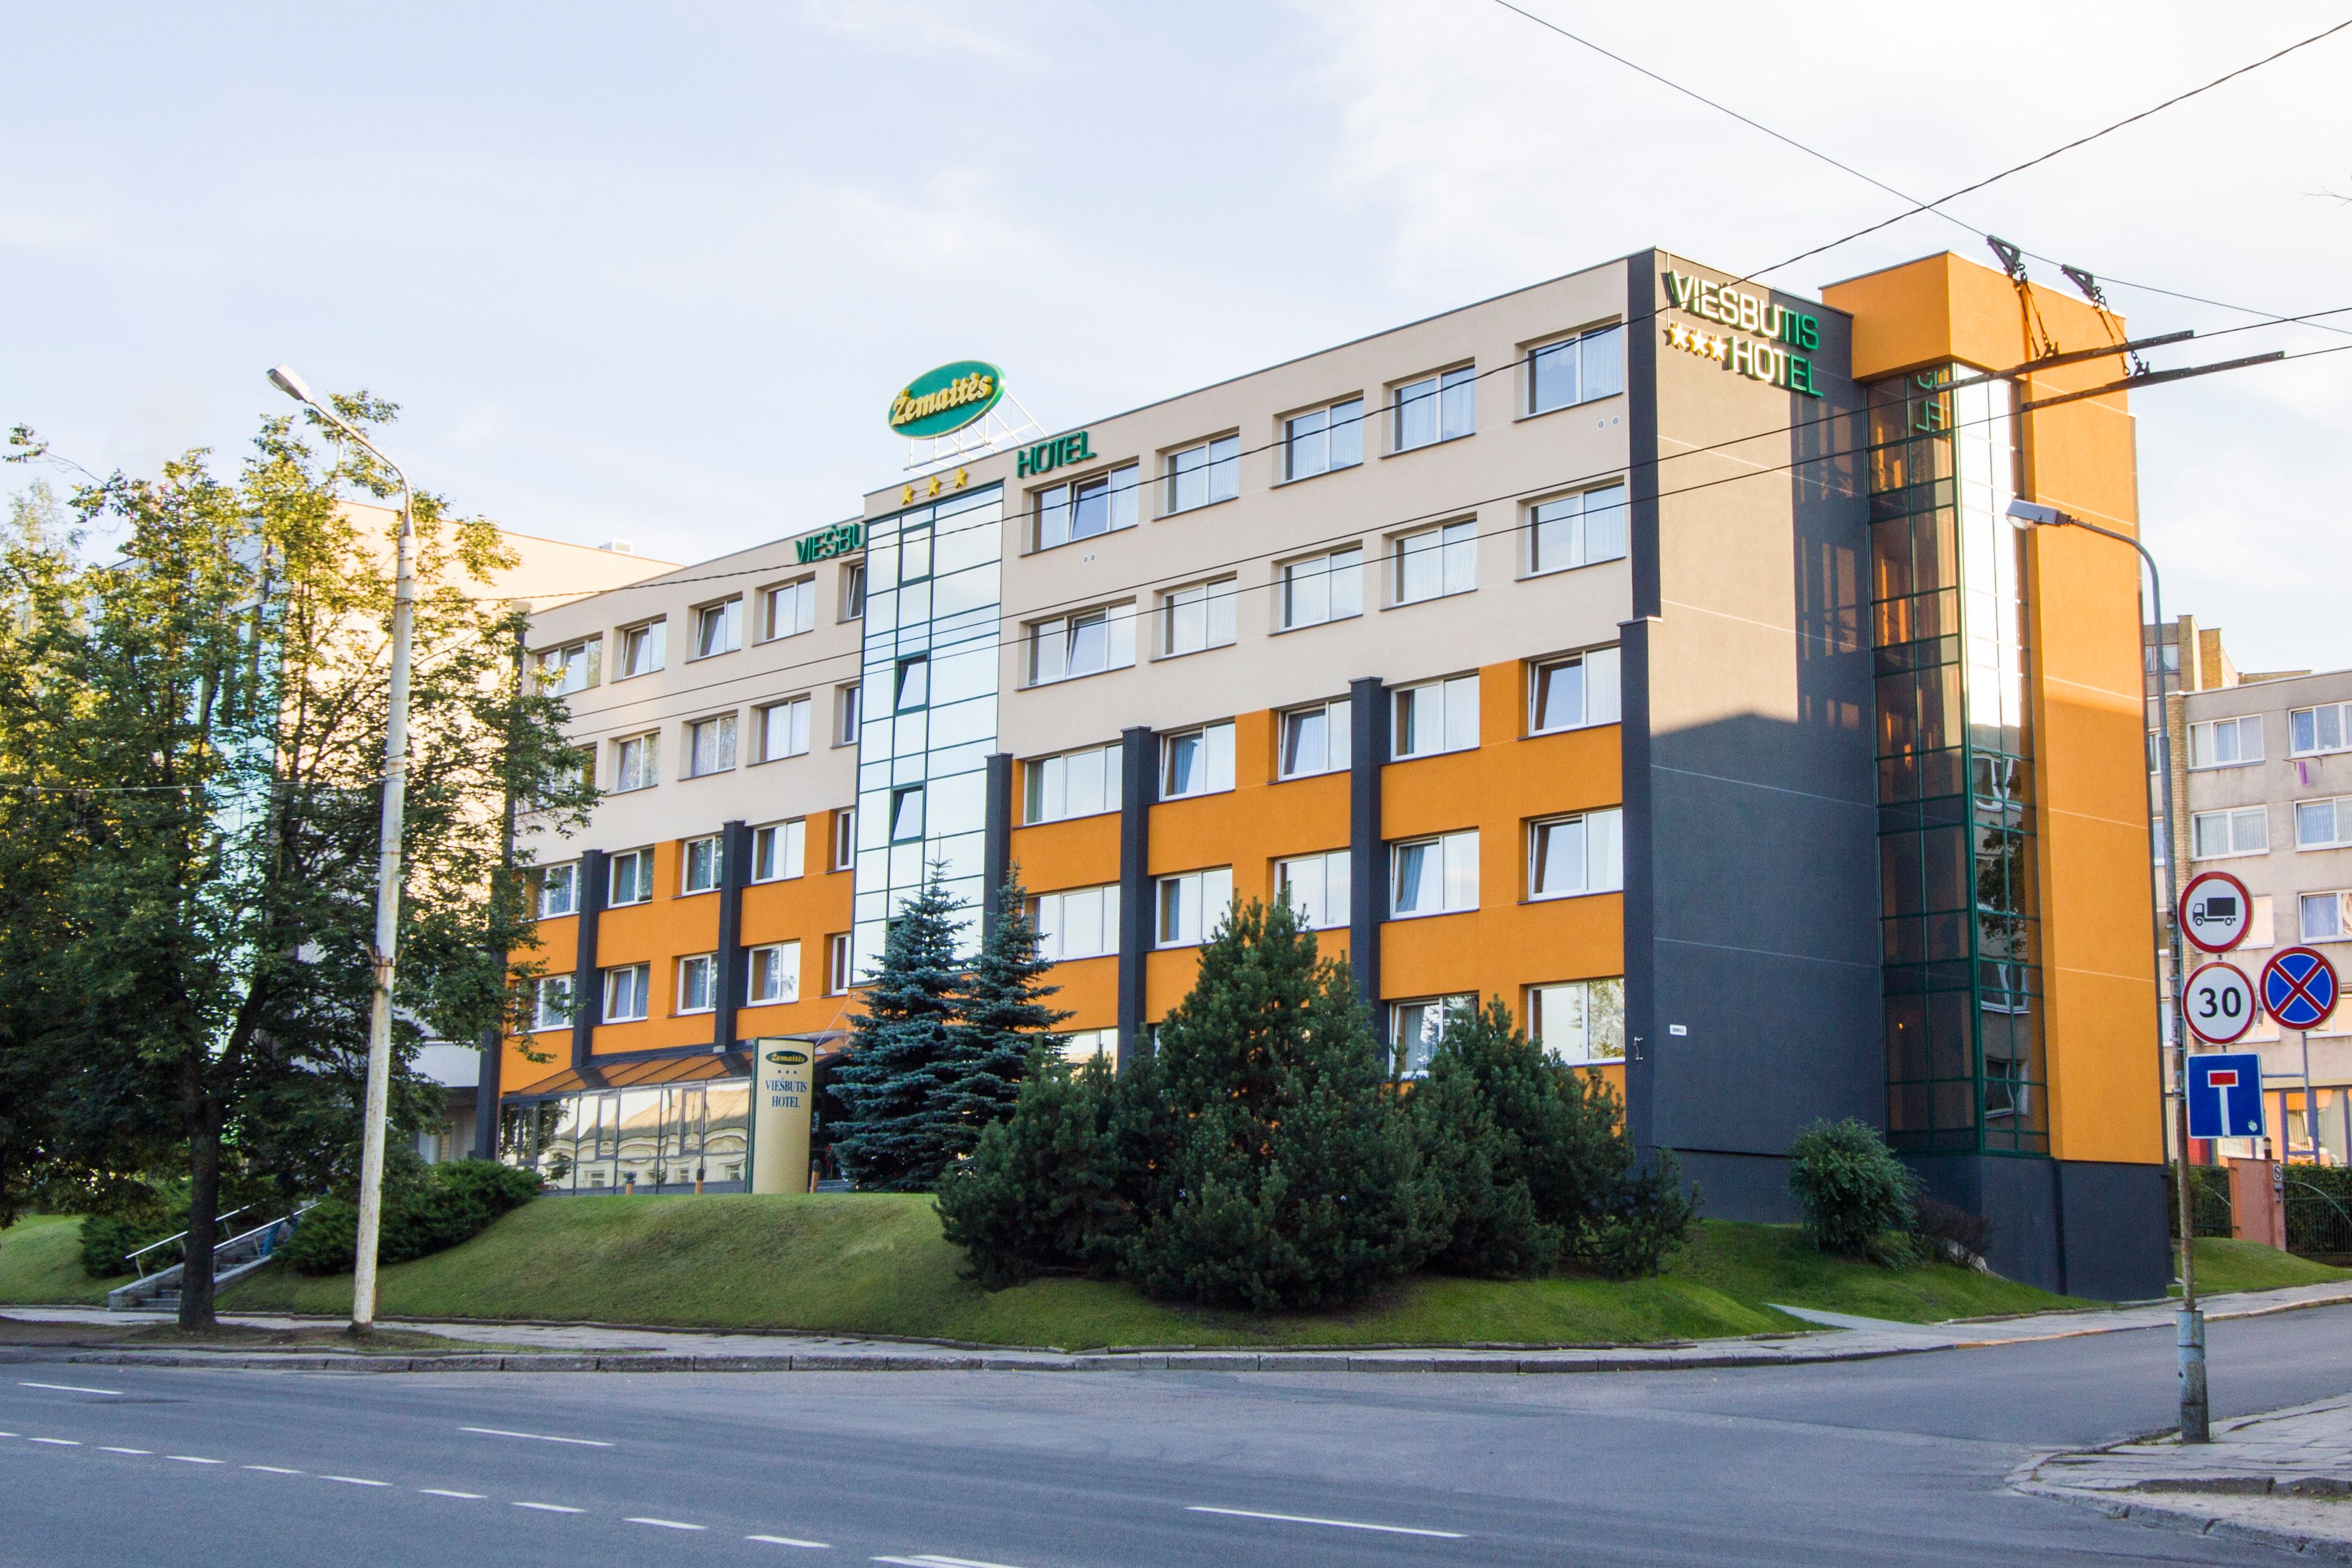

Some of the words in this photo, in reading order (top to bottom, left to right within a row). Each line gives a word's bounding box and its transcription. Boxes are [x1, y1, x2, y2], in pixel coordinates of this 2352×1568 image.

[1728, 335, 1824, 398] HOTEL
[891, 372, 993, 426] Žemaitės
[1017, 430, 1097, 478] HOTEL
[2198, 987, 2242, 1019] 30
[766, 1078, 807, 1093] VIEŠBUTIS
[772, 1096, 800, 1108] HOTEL
